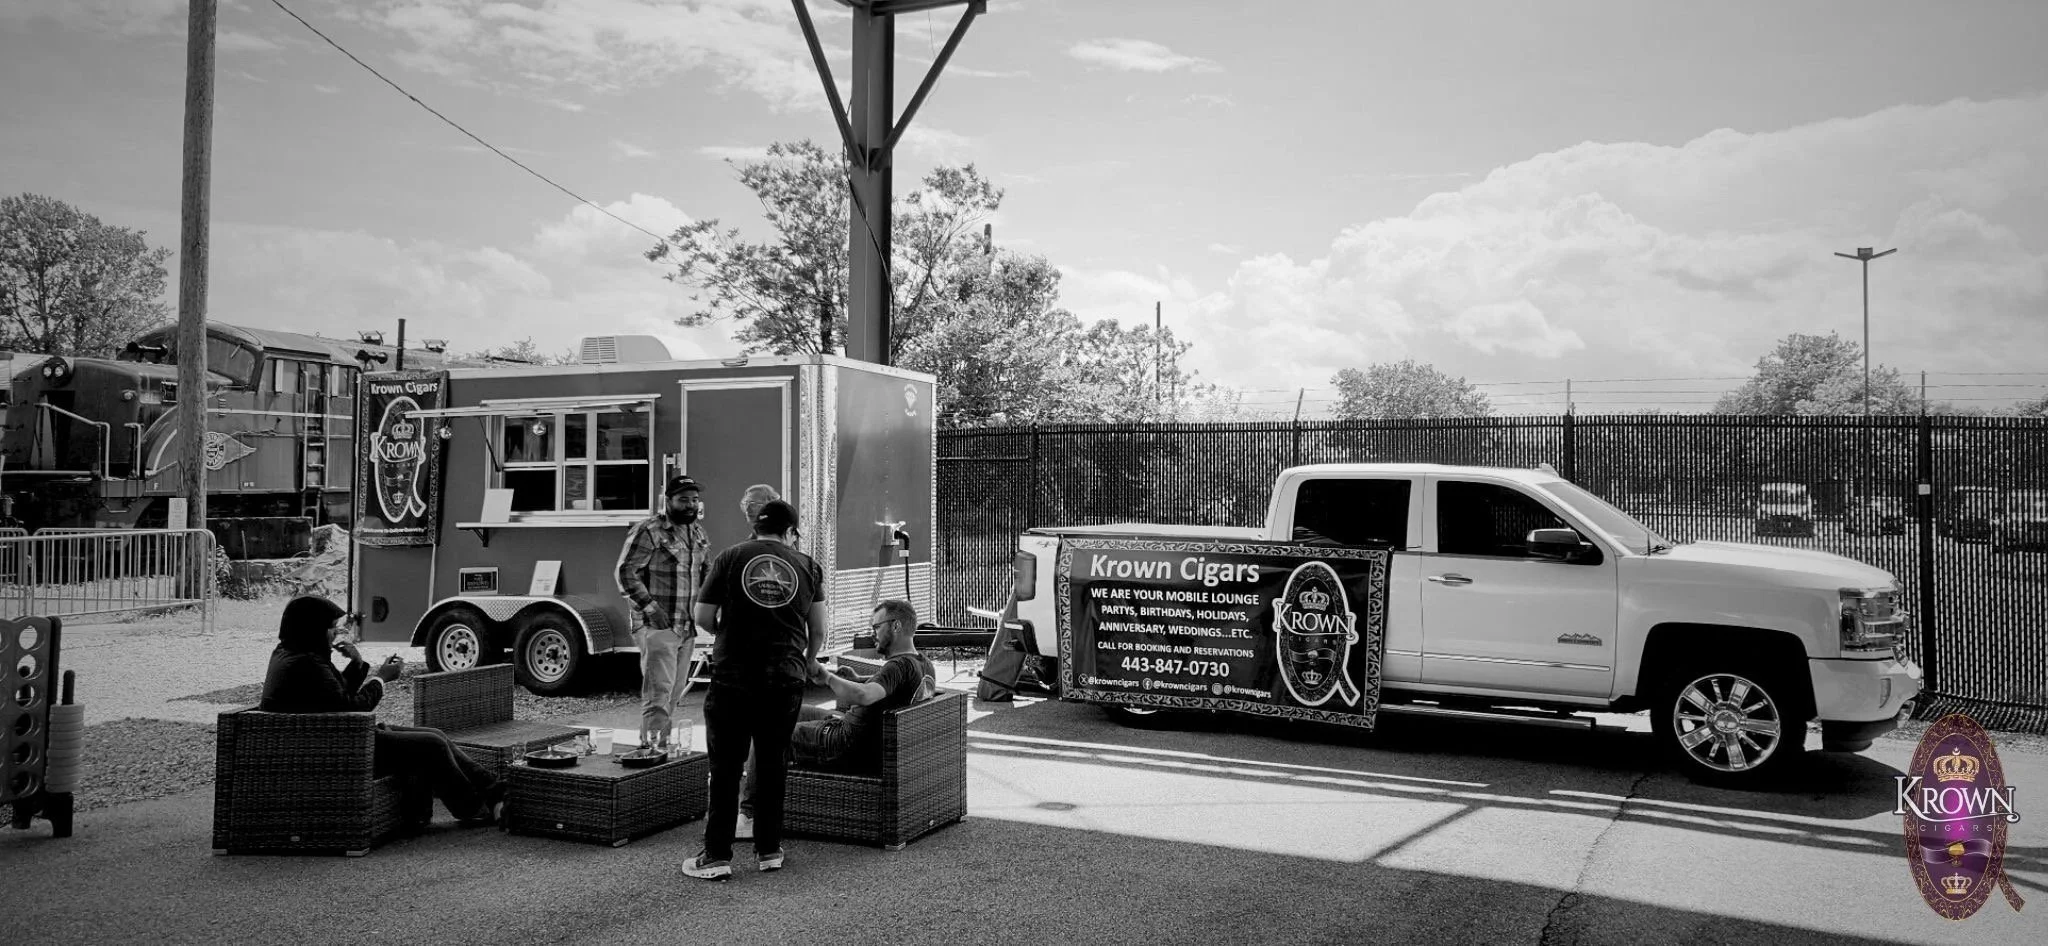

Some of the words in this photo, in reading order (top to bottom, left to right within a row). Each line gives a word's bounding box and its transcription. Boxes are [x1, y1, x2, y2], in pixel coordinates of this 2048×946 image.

[370, 383, 403, 395] Krown
[405, 381, 438, 396] Cigars
[1090, 554, 1171, 579] Krown
[1179, 556, 1260, 587] Cigars
[1091, 587, 1108, 599] WE
[1110, 588, 1131, 600] ARE
[1133, 589, 1163, 601] YOUR
[1166, 591, 1208, 603] MOBILE
[1211, 593, 1260, 605] LOUNGE
[1101, 604, 1138, 617] PARTYS,
[1140, 606, 1195, 620] BIRTHDAYS,
[1196, 609, 1249, 622] HOLIDAYS,
[1275, 601, 1356, 641] KROWN
[1099, 621, 1166, 636] ANNIVERSARY,
[1097, 641, 1117, 650] CALL
[1118, 642, 1134, 651] FOR
[1135, 643, 1172, 653] BOOKING
[1173, 645, 1192, 654] AND
[1193, 646, 1255, 658] RESERVATIONS
[1121, 656, 1230, 677] 443-847-0730
[1087, 676, 1140, 689] @krowncigars
[1153, 680, 1208, 693] @krowncigars
